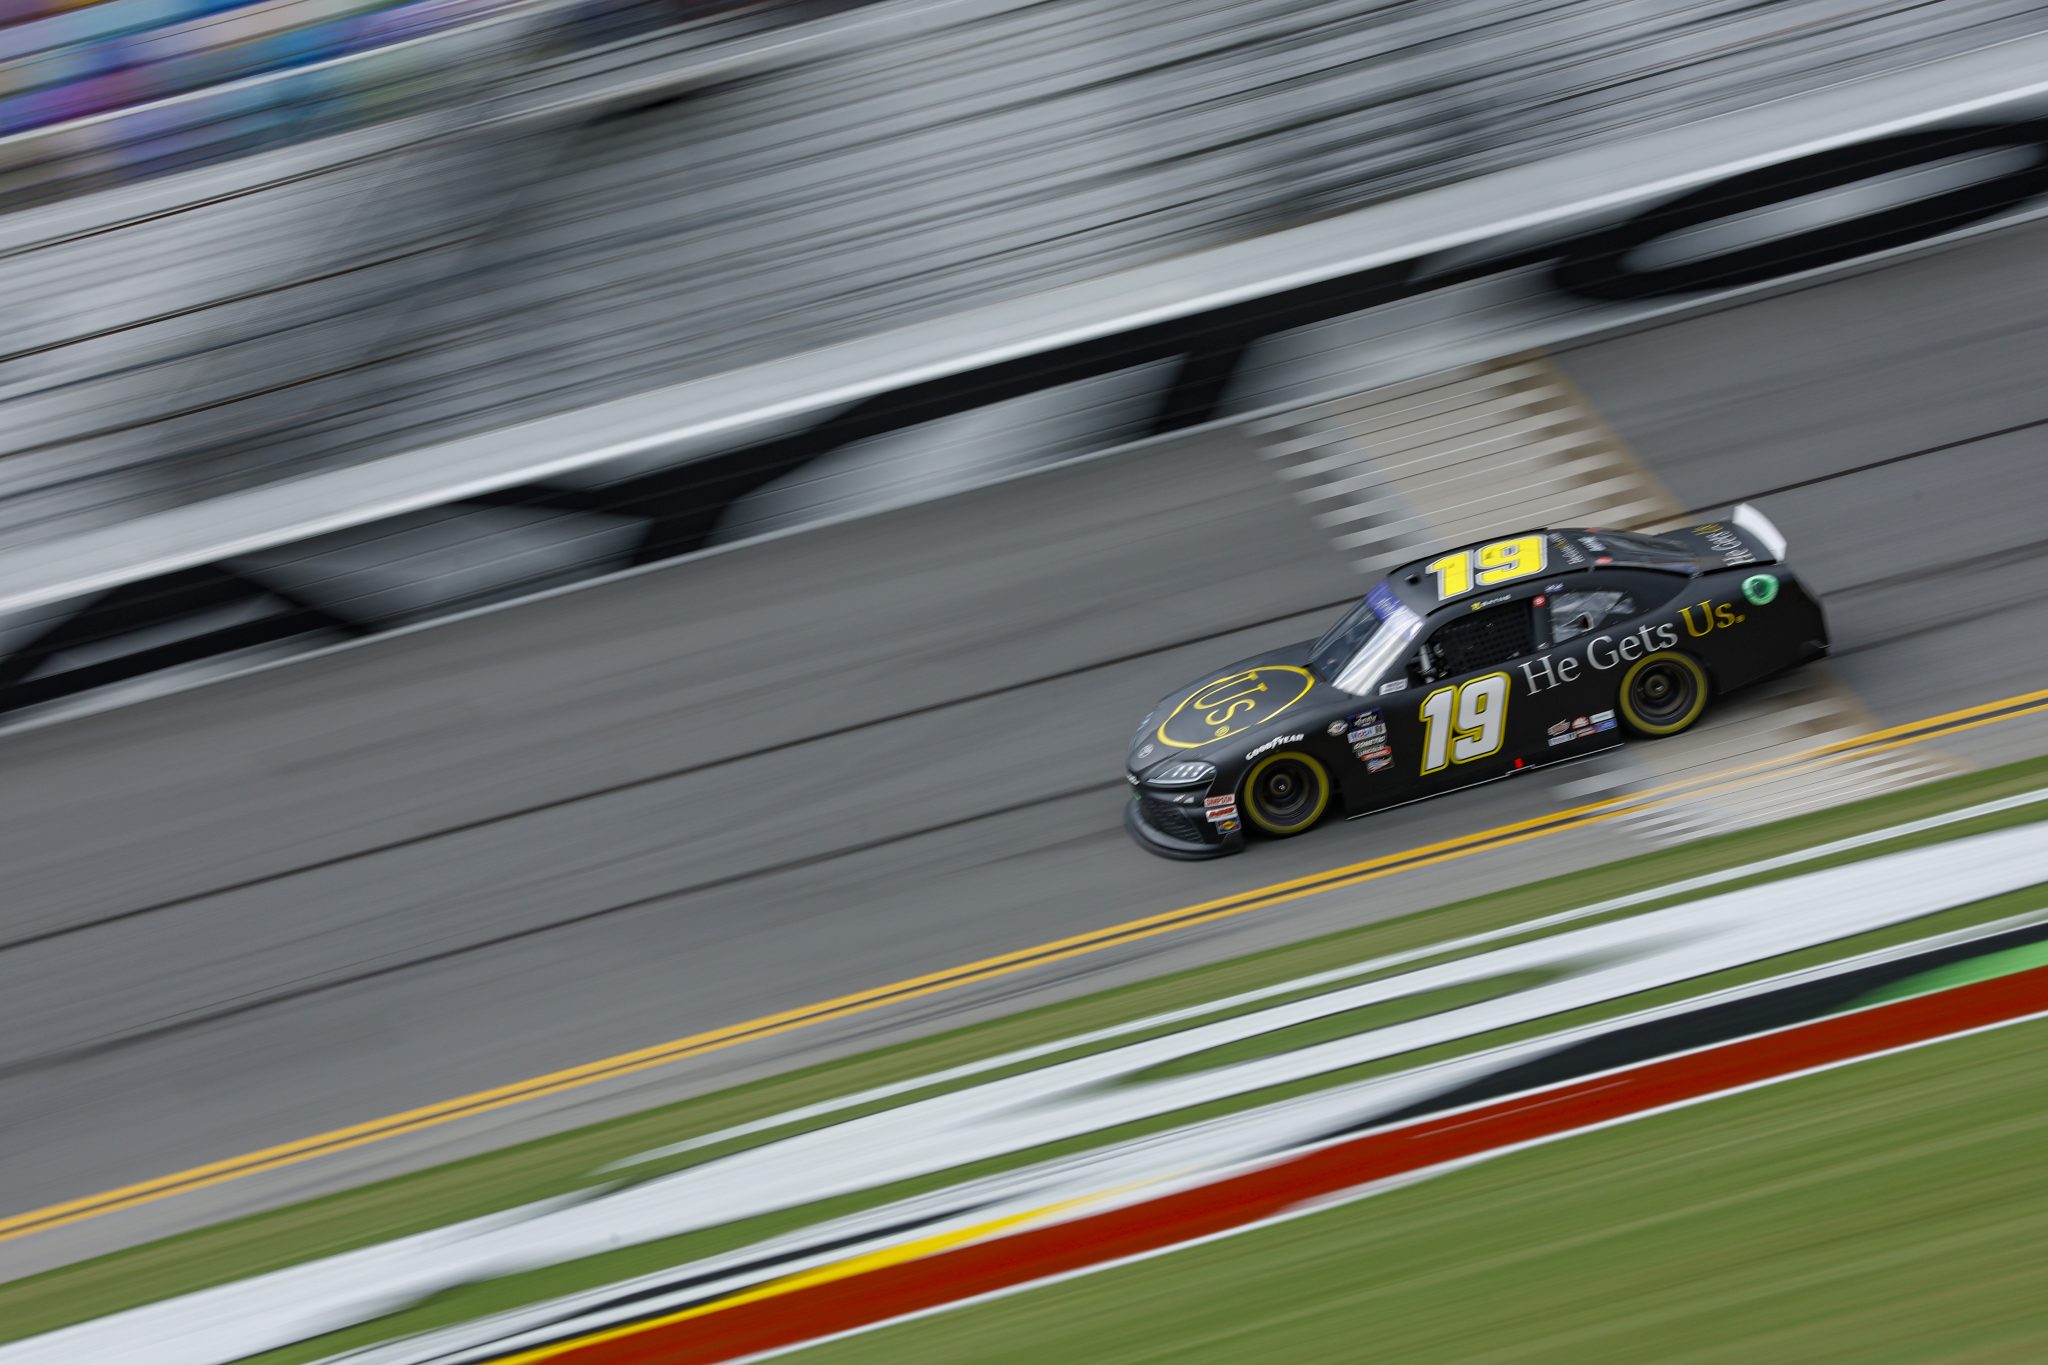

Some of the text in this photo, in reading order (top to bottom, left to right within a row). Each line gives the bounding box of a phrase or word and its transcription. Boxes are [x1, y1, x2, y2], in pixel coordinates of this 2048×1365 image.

[1426, 534, 1548, 600] 19
[1518, 600, 1746, 696] He Gets Us.
[1246, 733, 1305, 760] GOODYEAR
[1419, 672, 1511, 776] 19
